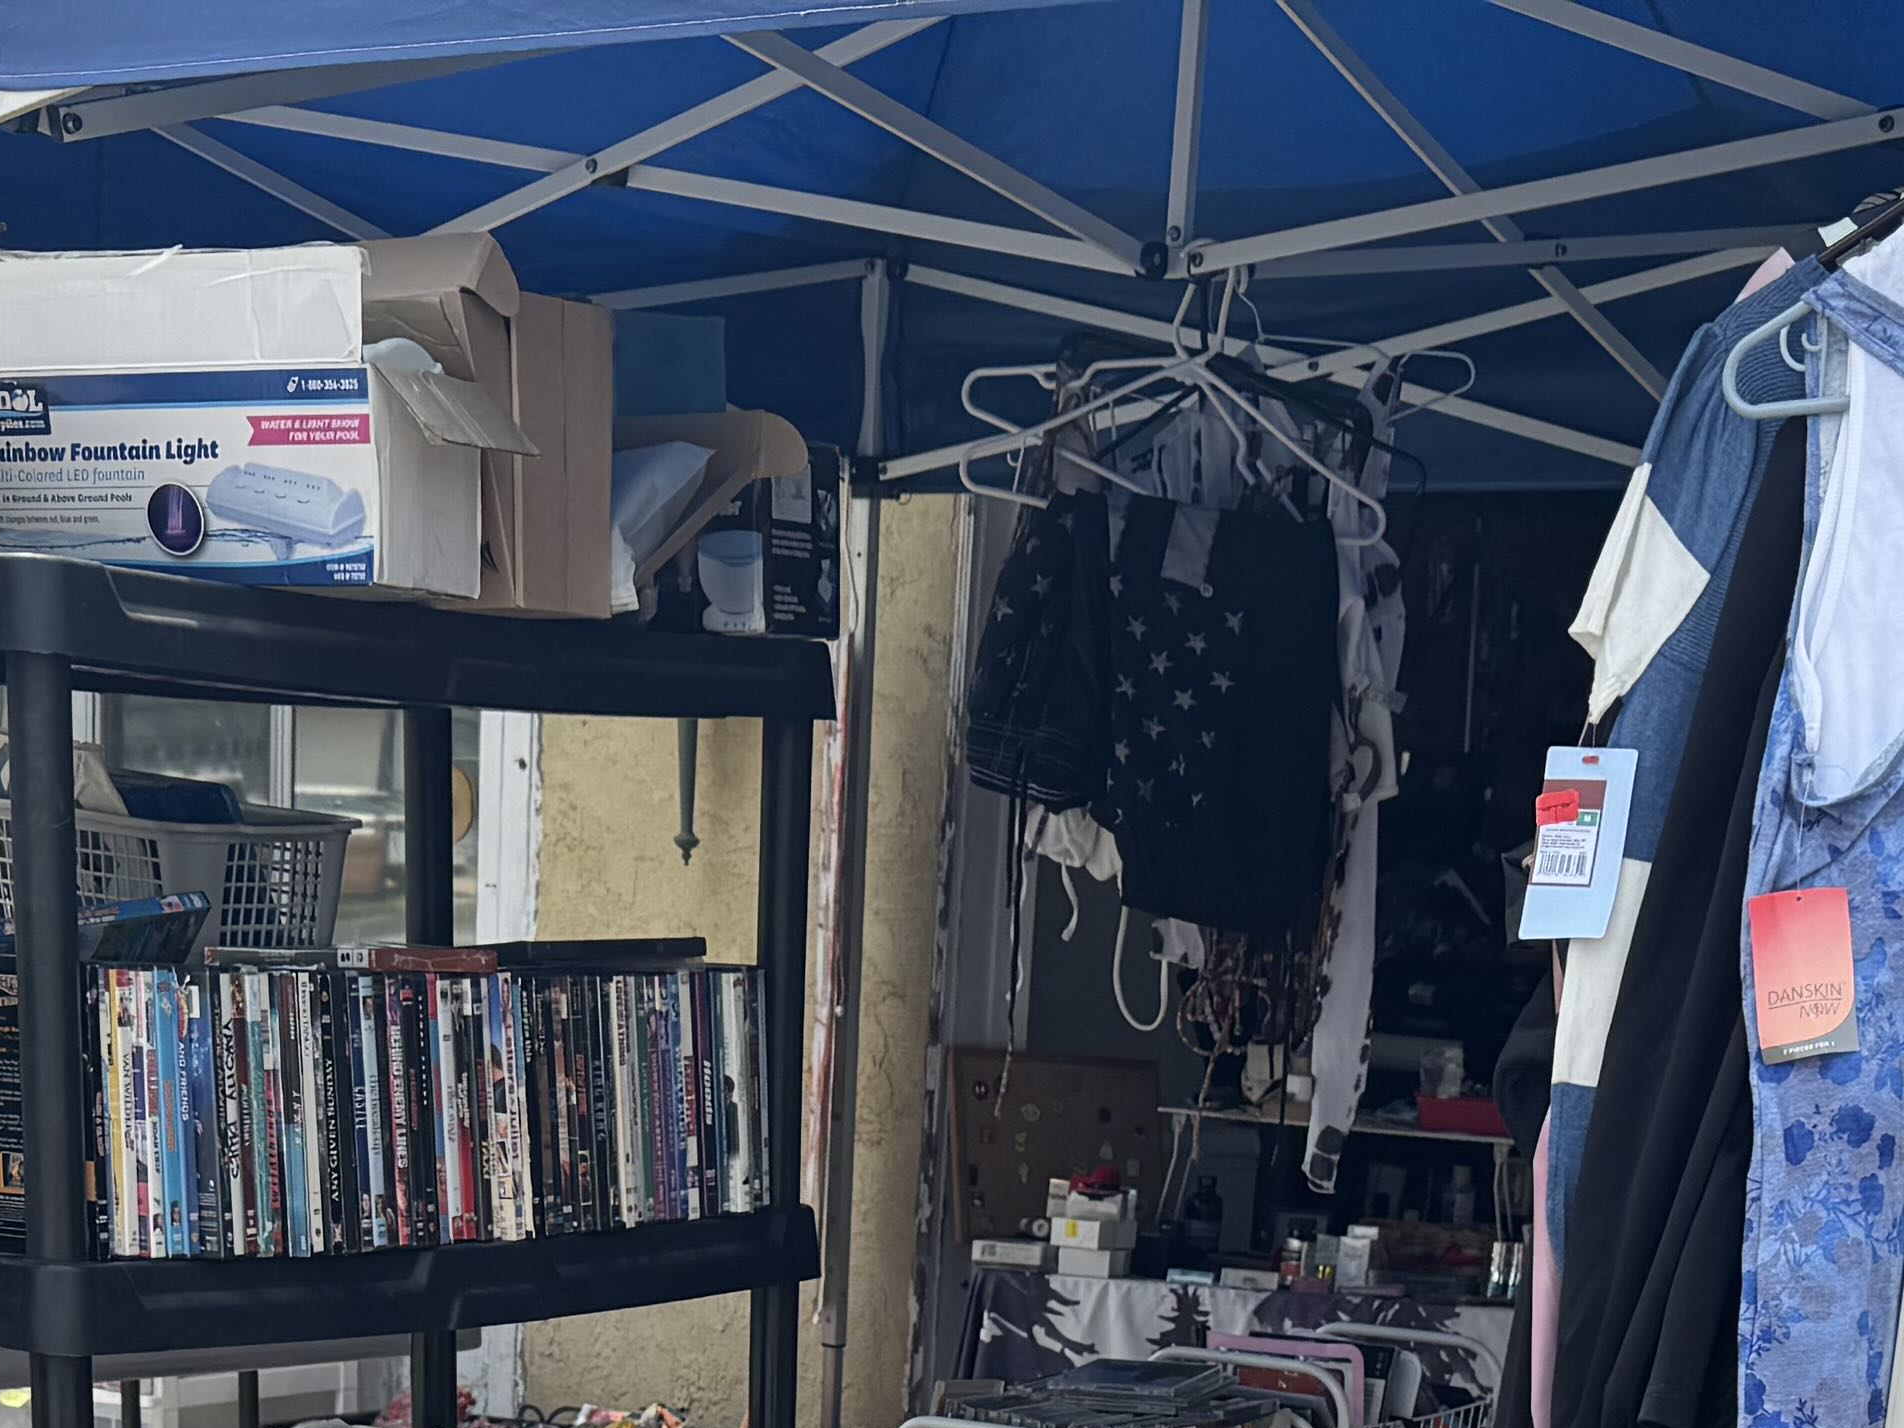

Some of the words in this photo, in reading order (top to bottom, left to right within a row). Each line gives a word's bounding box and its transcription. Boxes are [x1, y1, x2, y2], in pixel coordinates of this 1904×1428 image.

[70, 438, 161, 462] Fountain
[165, 437, 219, 465] Light
[67, 468, 90, 482] LED
[92, 467, 146, 484] fountain
[50, 493, 76, 503] Above
[78, 493, 109, 503] Ground
[110, 492, 132, 503] Pools
[1767, 982, 1843, 1007] DANSKIN
[122, 1053, 132, 1079] VAN
[177, 1041, 186, 1069] AND
[390, 1025, 404, 1077] BEHIND
[178, 1070, 190, 1122] FRIENDS
[324, 1057, 336, 1116] SUNDAY
[393, 1078, 407, 1126] ENEMY
[504, 1024, 513, 1094] Letters
[509, 1108, 521, 1161] Juliet
[703, 1059, 713, 1126] Hoods
[327, 1119, 339, 1167] GIVEN
[396, 1127, 410, 1169] LINES
[329, 1170, 341, 1202] ANY
